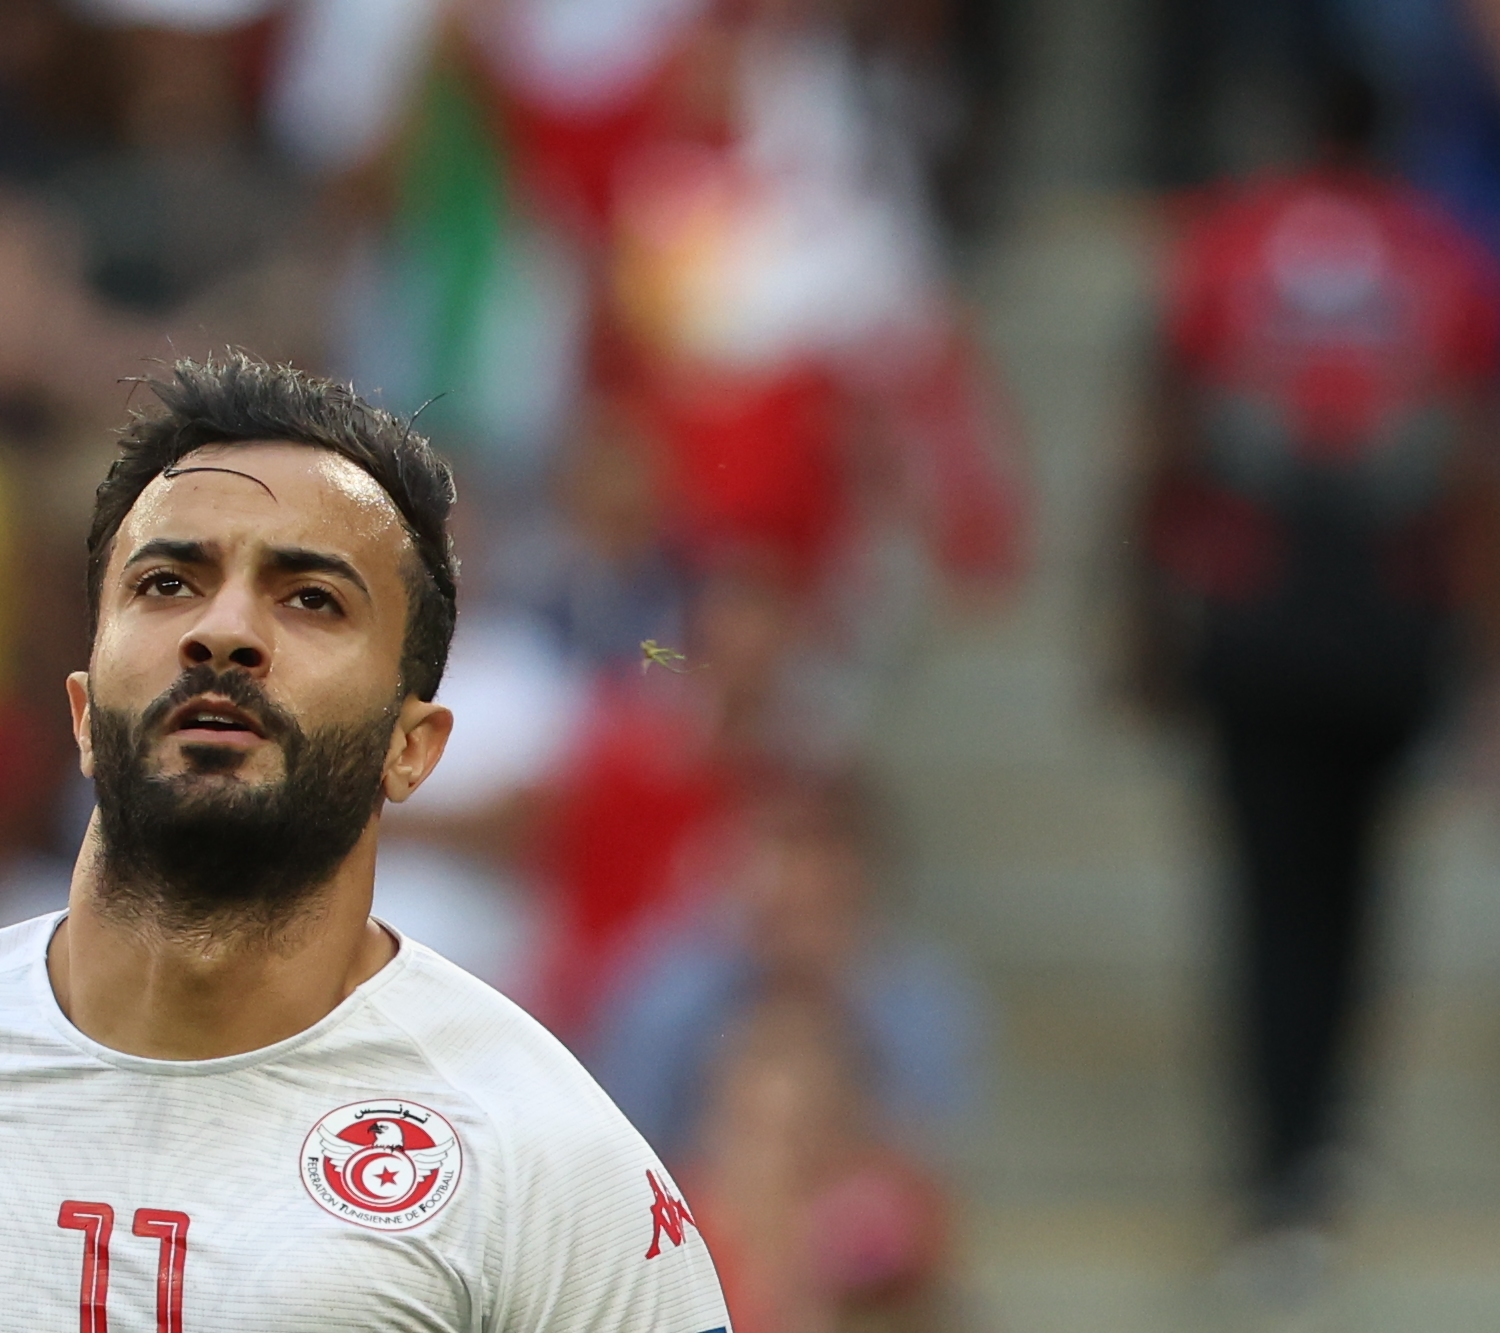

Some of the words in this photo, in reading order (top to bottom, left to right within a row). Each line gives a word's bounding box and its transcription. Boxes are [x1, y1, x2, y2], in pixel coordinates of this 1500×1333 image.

[308, 1156, 339, 1208] FEDERATION
[338, 1203, 403, 1224] TUNISIENNE
[405, 1209, 420, 1222] DE
[418, 1169, 455, 1213] FOOTBALL
